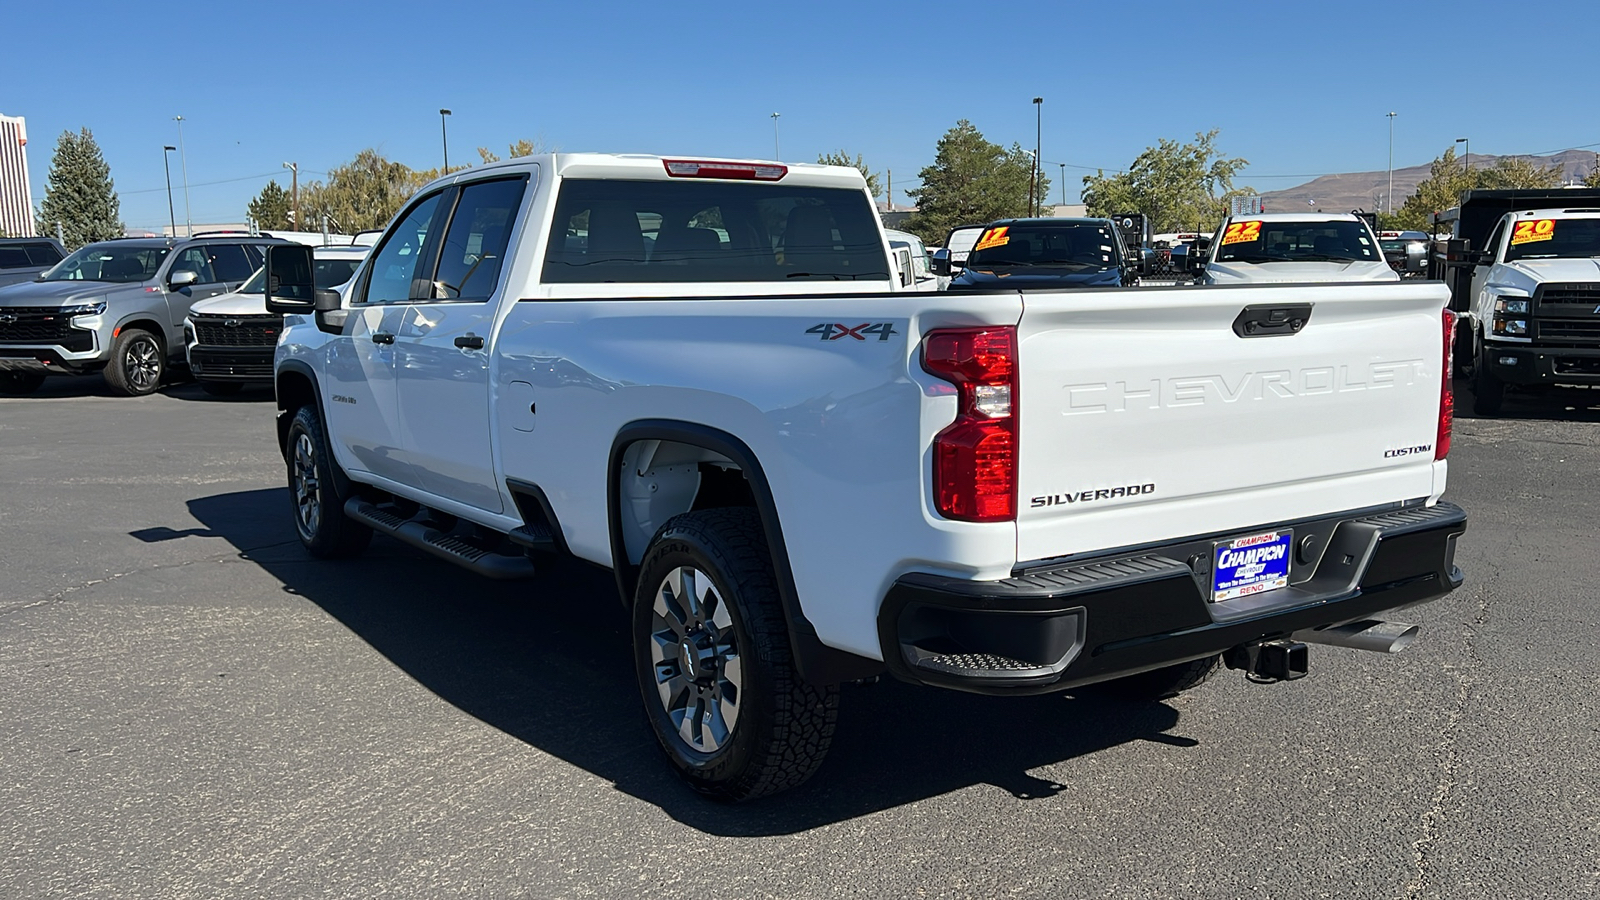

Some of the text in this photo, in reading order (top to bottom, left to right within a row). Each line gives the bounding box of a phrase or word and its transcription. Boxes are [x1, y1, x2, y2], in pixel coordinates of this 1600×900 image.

[981, 227, 1008, 243] 17
[1225, 221, 1260, 237] 22
[1516, 220, 1553, 235] 20
[1062, 359, 1424, 415] CHEVROLET
[1384, 444, 1431, 458] CUSTOM
[1030, 483, 1155, 508] SILVERADO
[1236, 534, 1274, 547] CHAMPION
[1218, 544, 1286, 569] CHAMPION
[1237, 565, 1263, 575] CHEVROLET
[1240, 584, 1264, 594] RENO
